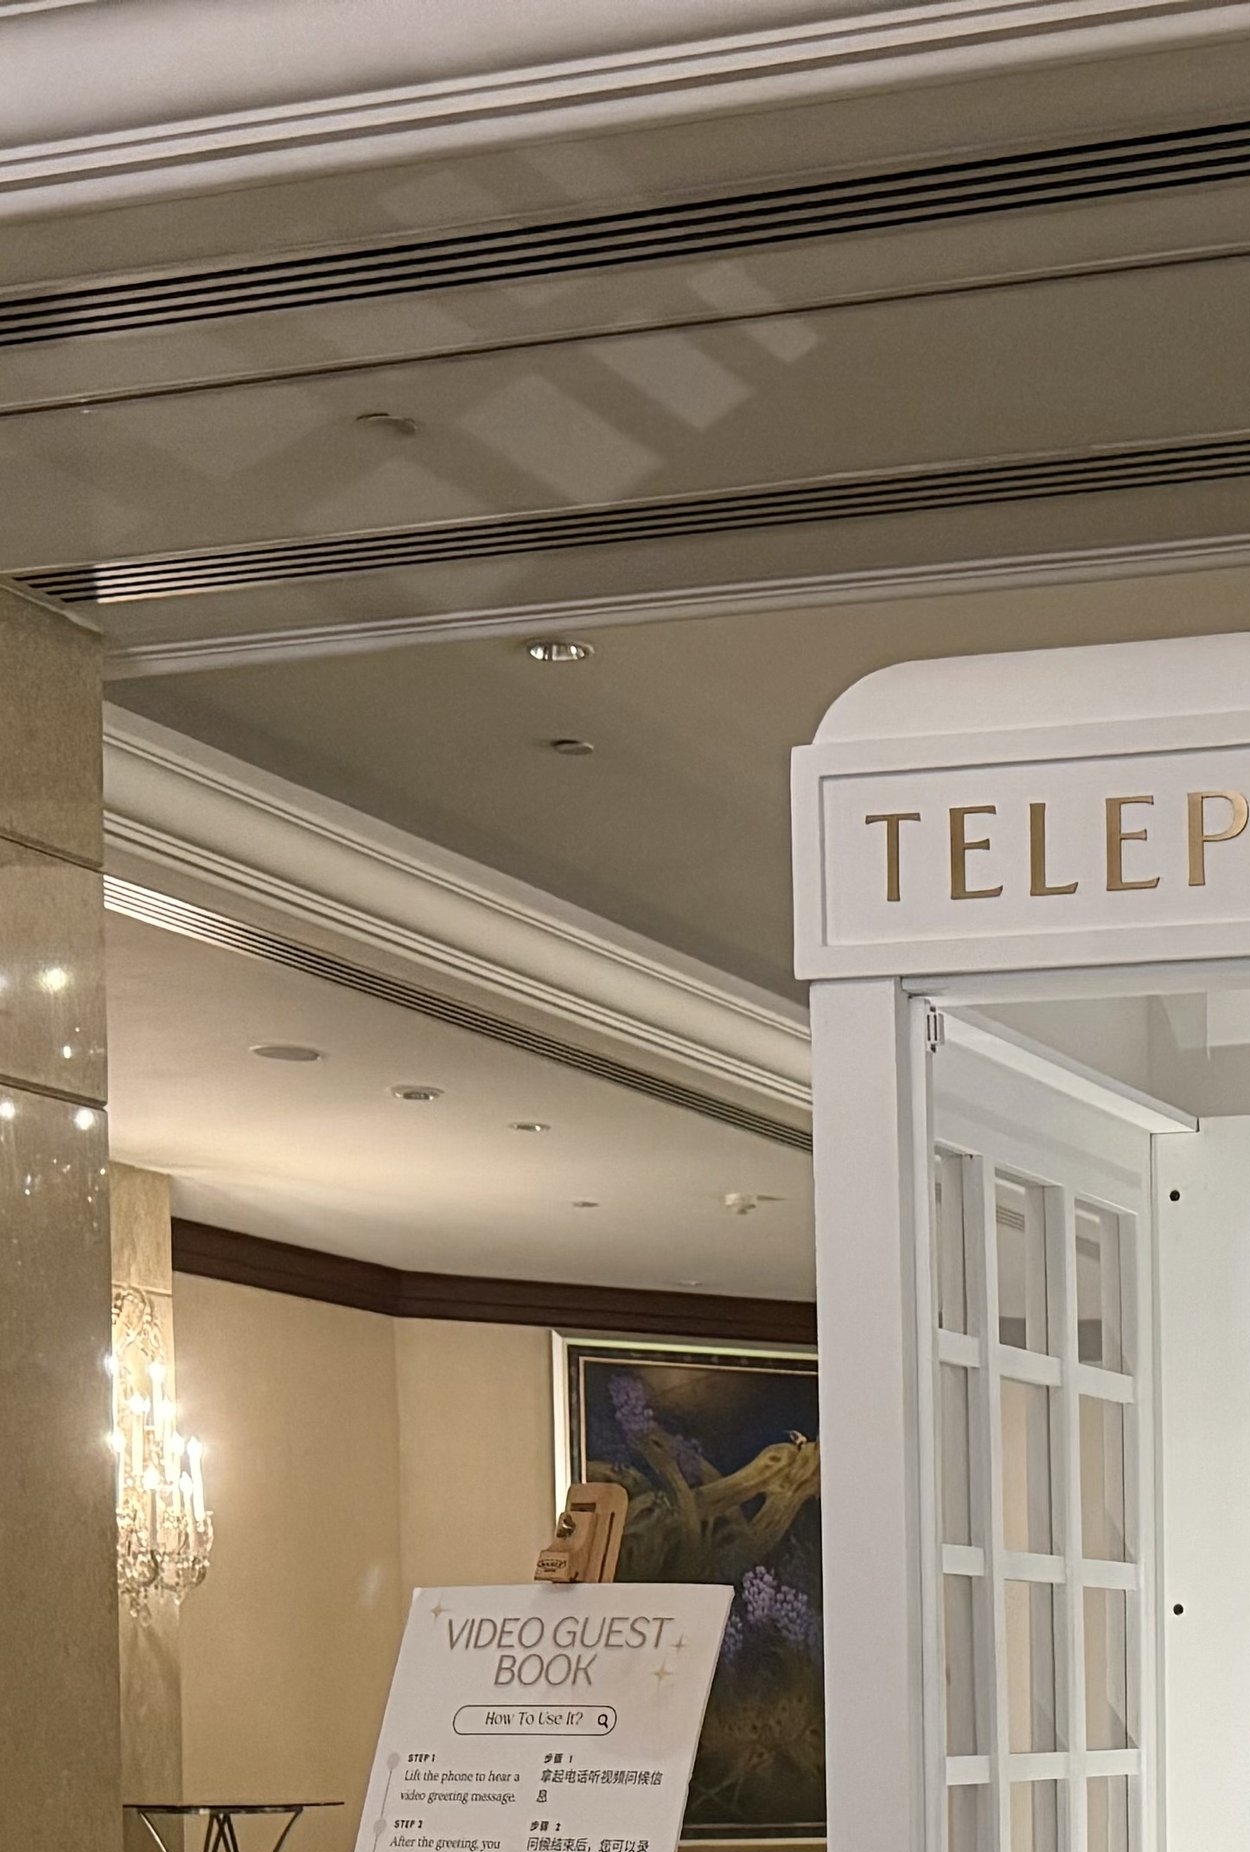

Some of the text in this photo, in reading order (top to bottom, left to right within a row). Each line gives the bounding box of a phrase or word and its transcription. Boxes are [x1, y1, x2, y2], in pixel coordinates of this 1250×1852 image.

[447, 1616, 675, 1650] VIDEO GUEST
[494, 1653, 598, 1686] BOOK
[485, 1711, 584, 1726] How To Use It?
[407, 1753, 431, 1763] STEP
[544, 1753, 564, 1763] 步骤
[404, 1769, 421, 1782] Lift
[423, 1770, 439, 1782] the
[440, 1770, 473, 1784] phone
[475, 1772, 485, 1782] to
[488, 1770, 511, 1782] hear
[540, 1768, 664, 1786] 拿起电话听视频问候信
[400, 1789, 425, 1800] video
[427, 1790, 469, 1805] greeting
[536, 1788, 548, 1803] 息
[394, 1819, 415, 1829] STEP
[530, 1820, 549, 1832] 步骤
[389, 1835, 416, 1847] After
[418, 1836, 433, 1848] the
[480, 1840, 501, 1852] you
